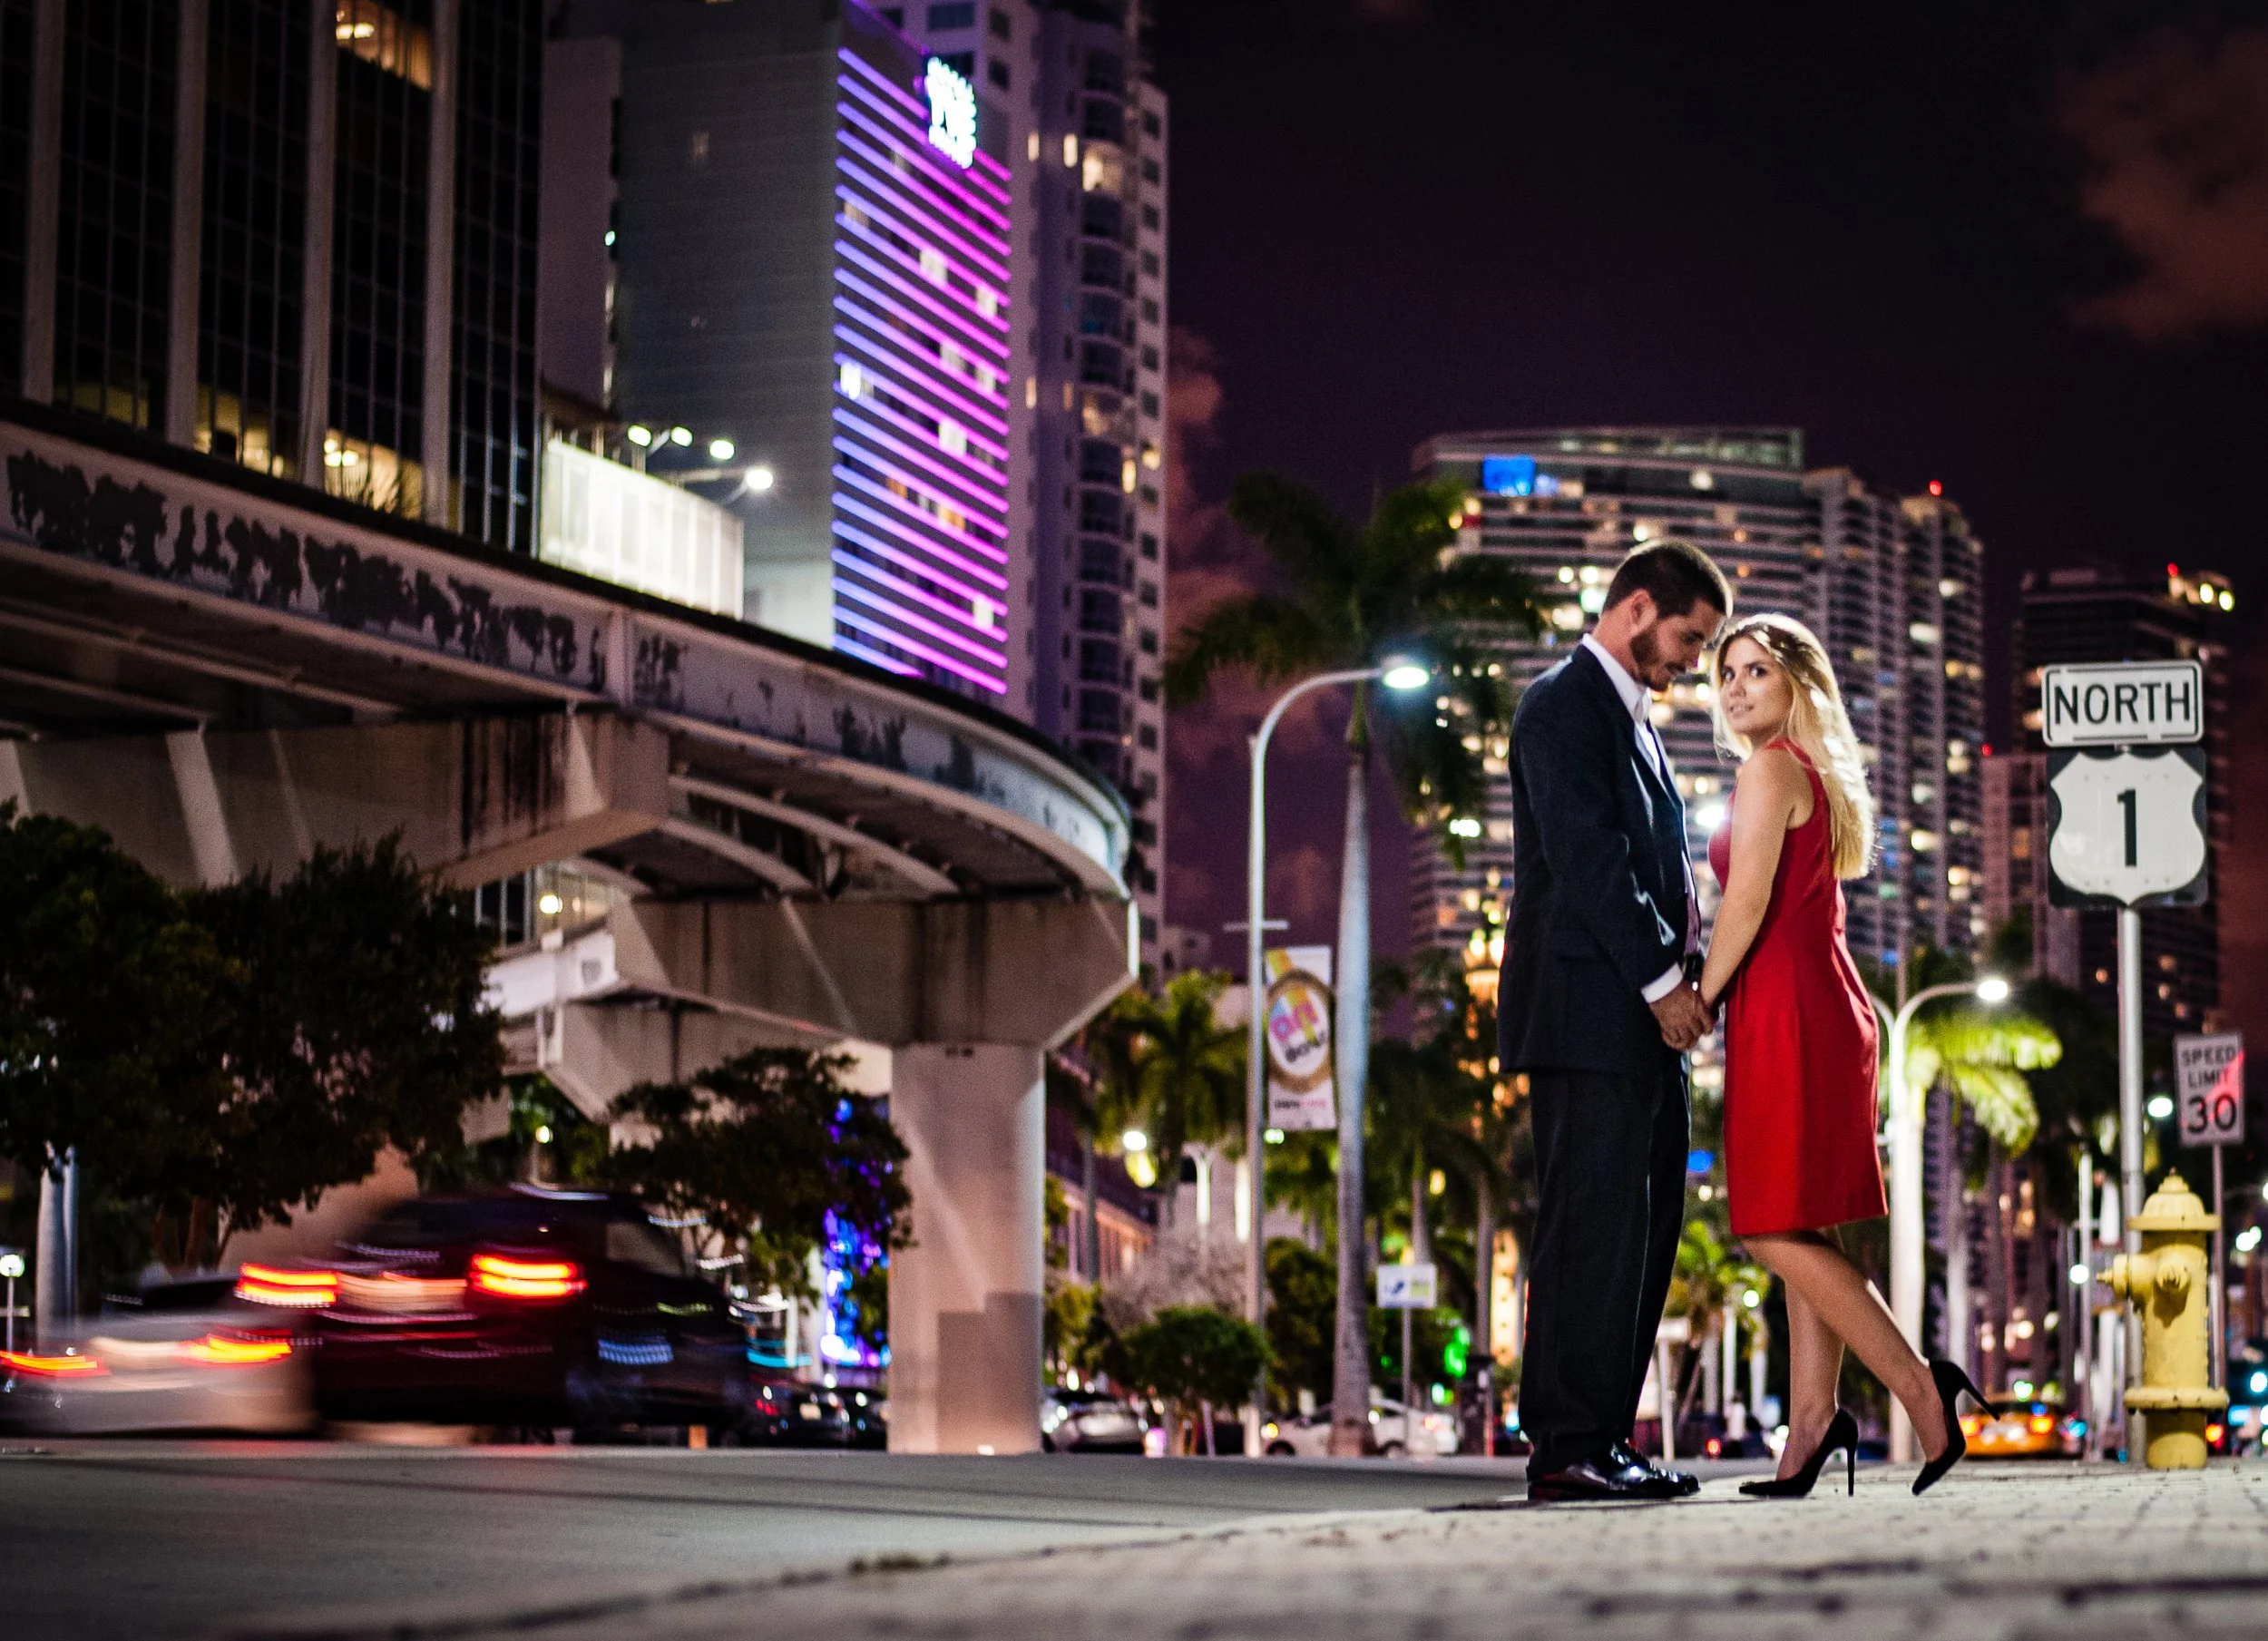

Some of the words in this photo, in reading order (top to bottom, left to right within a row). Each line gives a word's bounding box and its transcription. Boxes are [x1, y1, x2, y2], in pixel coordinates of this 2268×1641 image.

[2053, 681, 2191, 725] NORTH
[2116, 788, 2137, 867] 1
[2181, 1044, 2236, 1067] SPEED
[2187, 1068, 2231, 1088] LIMIT
[2186, 1094, 2237, 1134] 30
